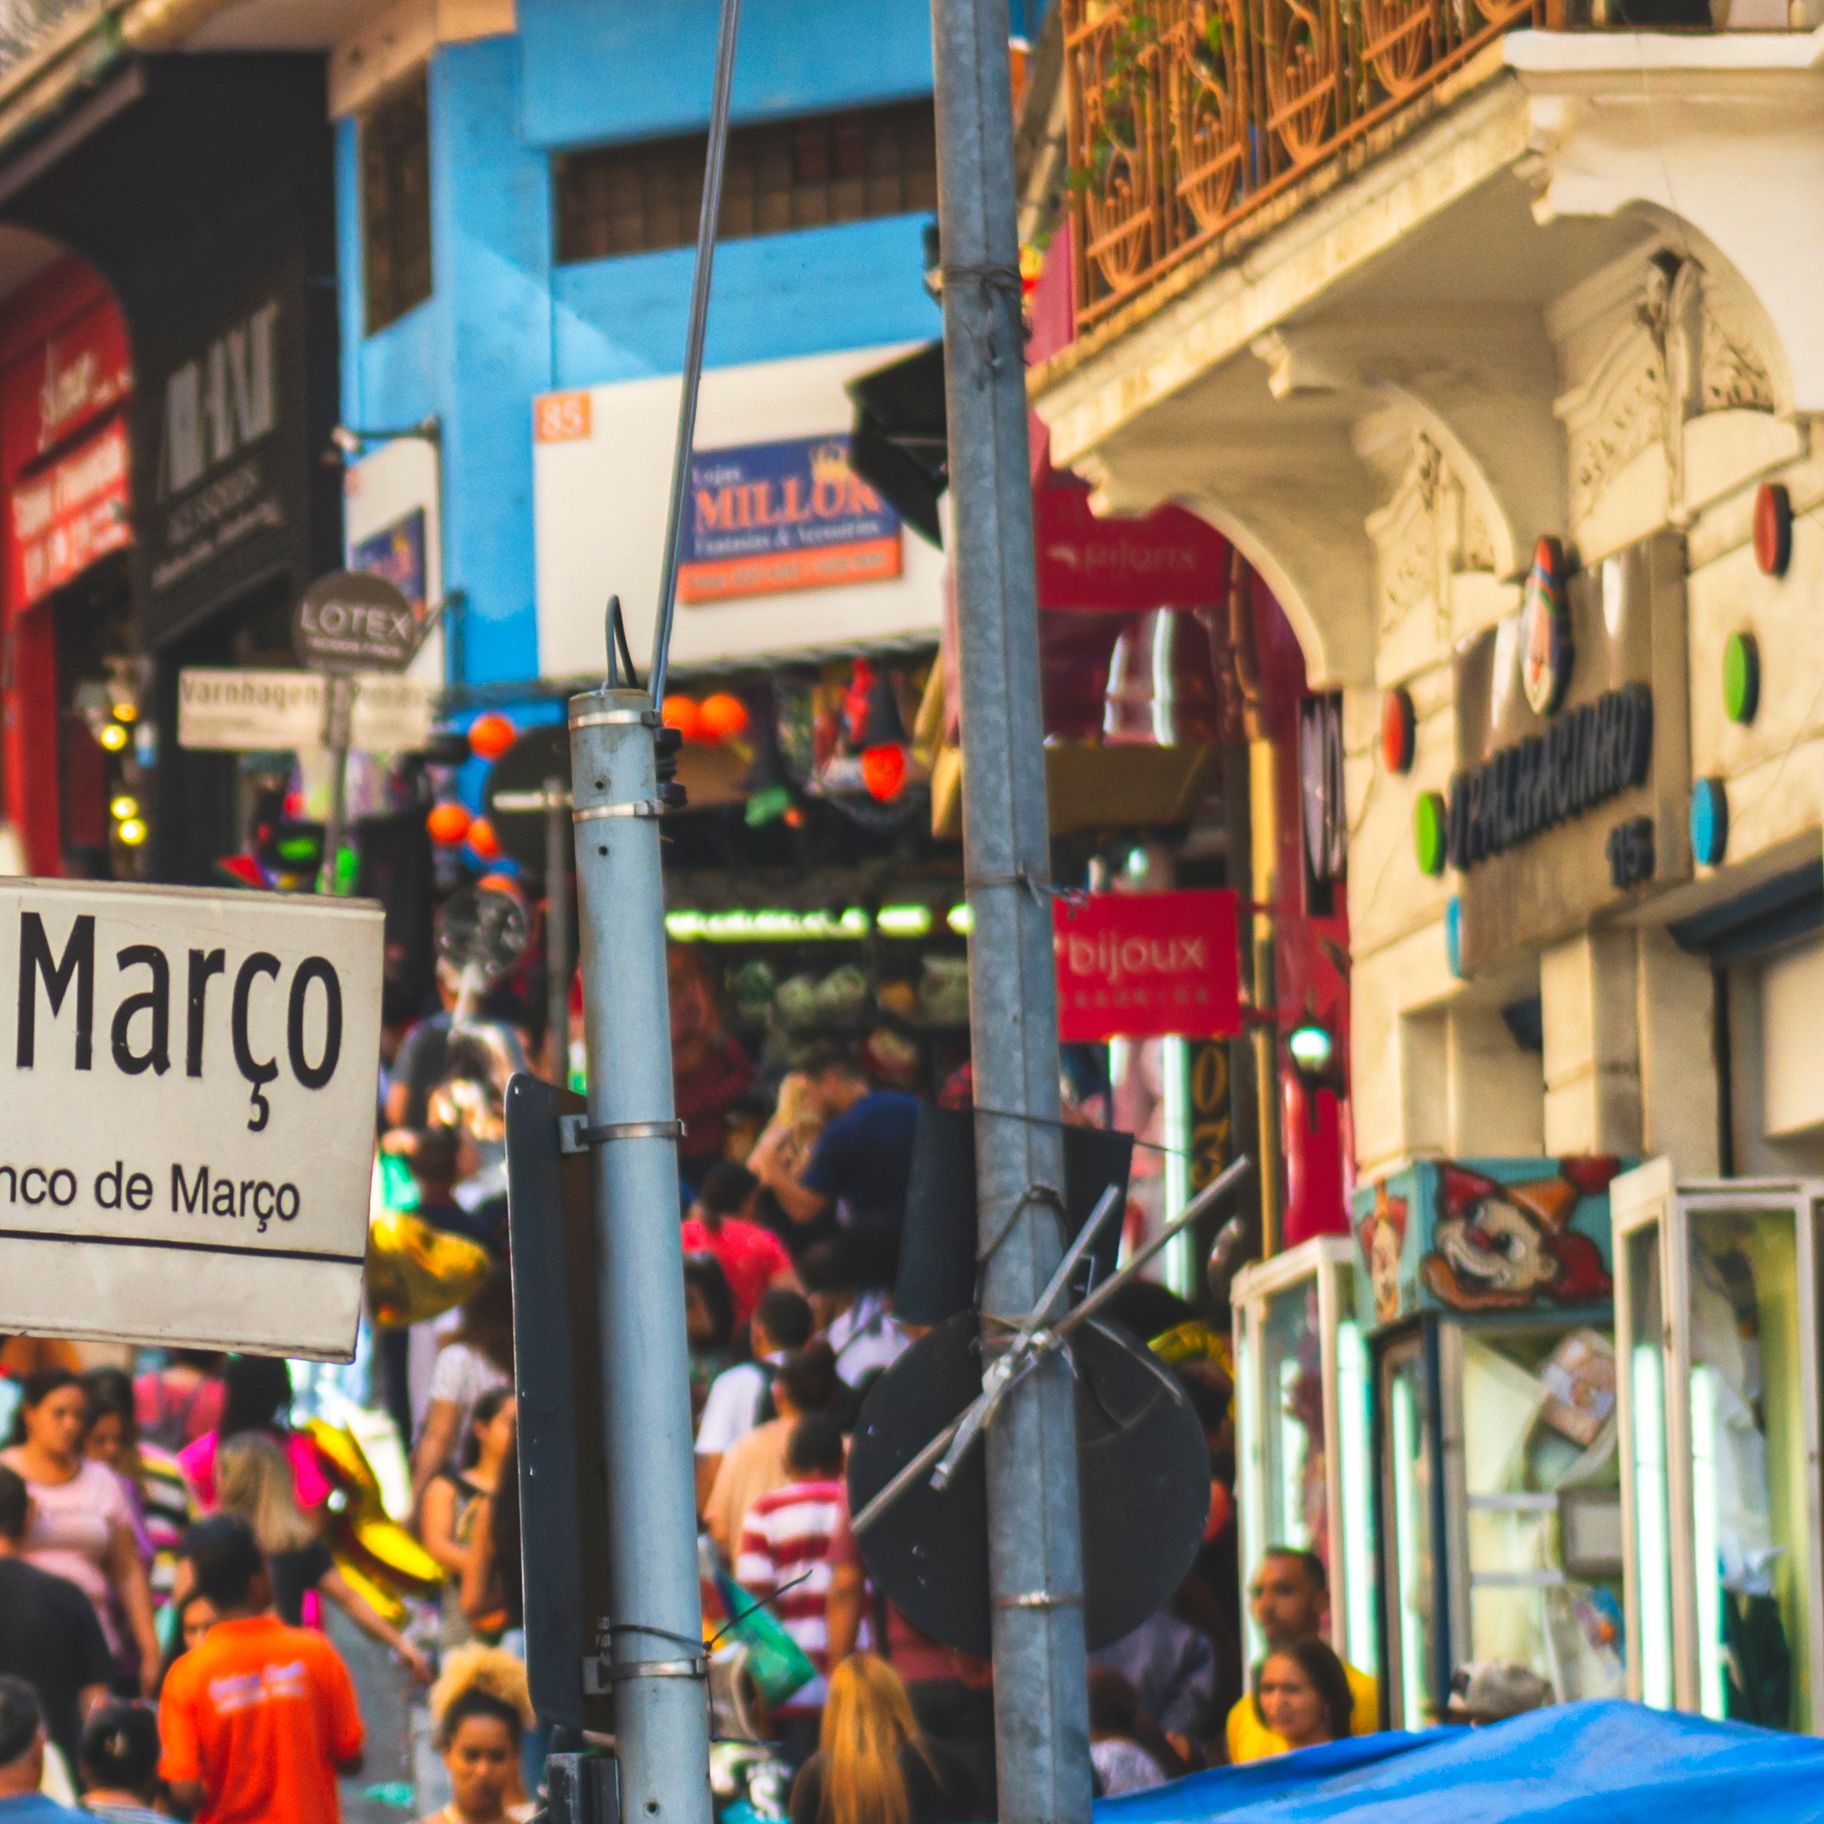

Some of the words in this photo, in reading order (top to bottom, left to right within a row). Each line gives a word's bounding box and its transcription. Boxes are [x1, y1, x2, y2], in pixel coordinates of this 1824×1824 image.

[302, 601, 410, 639] LOTEX
[1068, 929, 1204, 984] bijoux
[16, 911, 344, 1132] Março
[92, 1158, 154, 1214] de
[169, 1163, 302, 1234] Março
